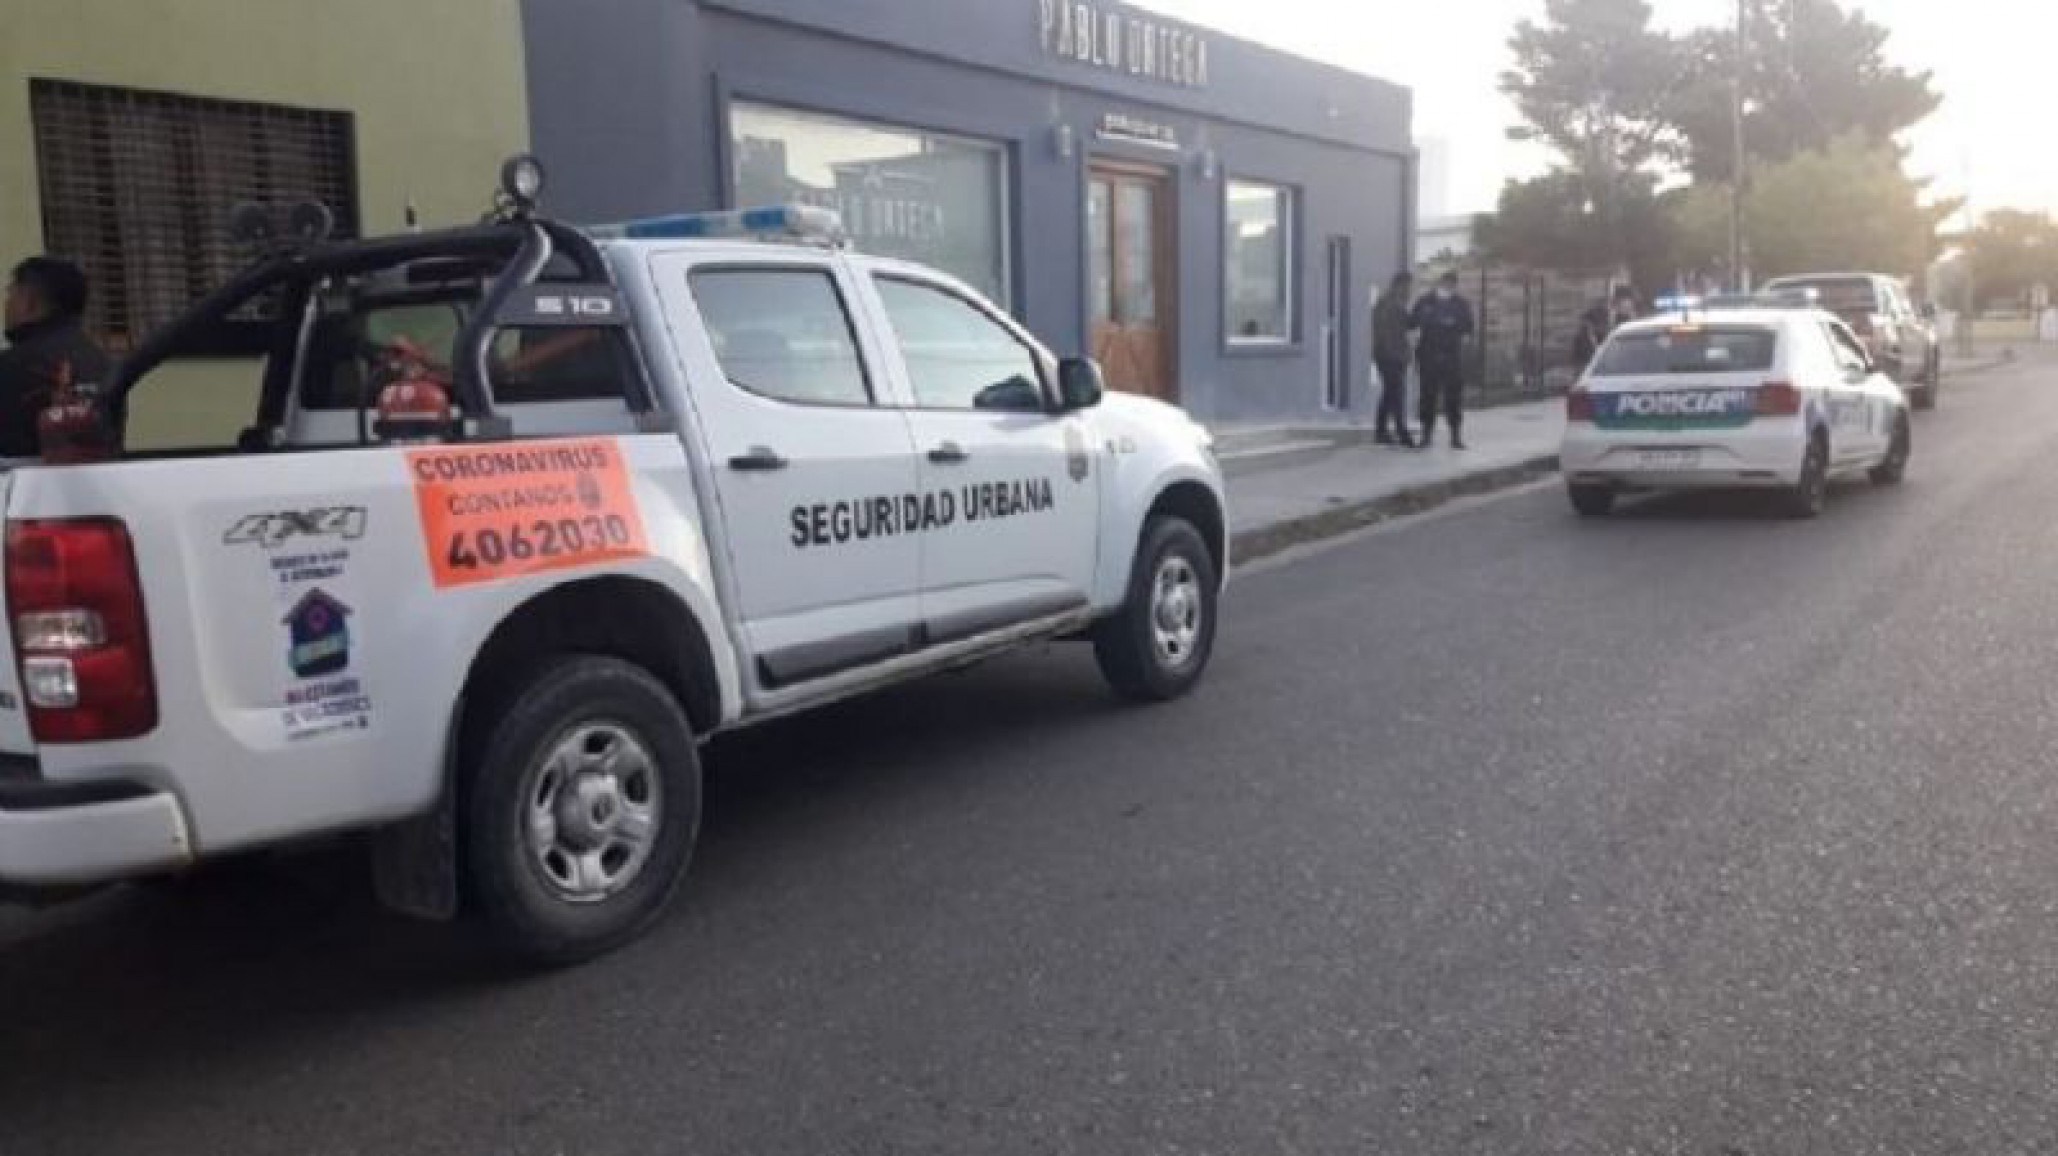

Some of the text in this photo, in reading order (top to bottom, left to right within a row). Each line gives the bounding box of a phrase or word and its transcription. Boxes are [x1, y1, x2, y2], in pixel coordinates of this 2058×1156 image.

[1040, 0, 1208, 86] PABLO ORTEGA
[535, 295, 612, 314] S10
[414, 446, 608, 481] CORONAVIRUS
[789, 476, 1054, 548] SEGURIDAD URBANA
[447, 514, 629, 570] 4062030
